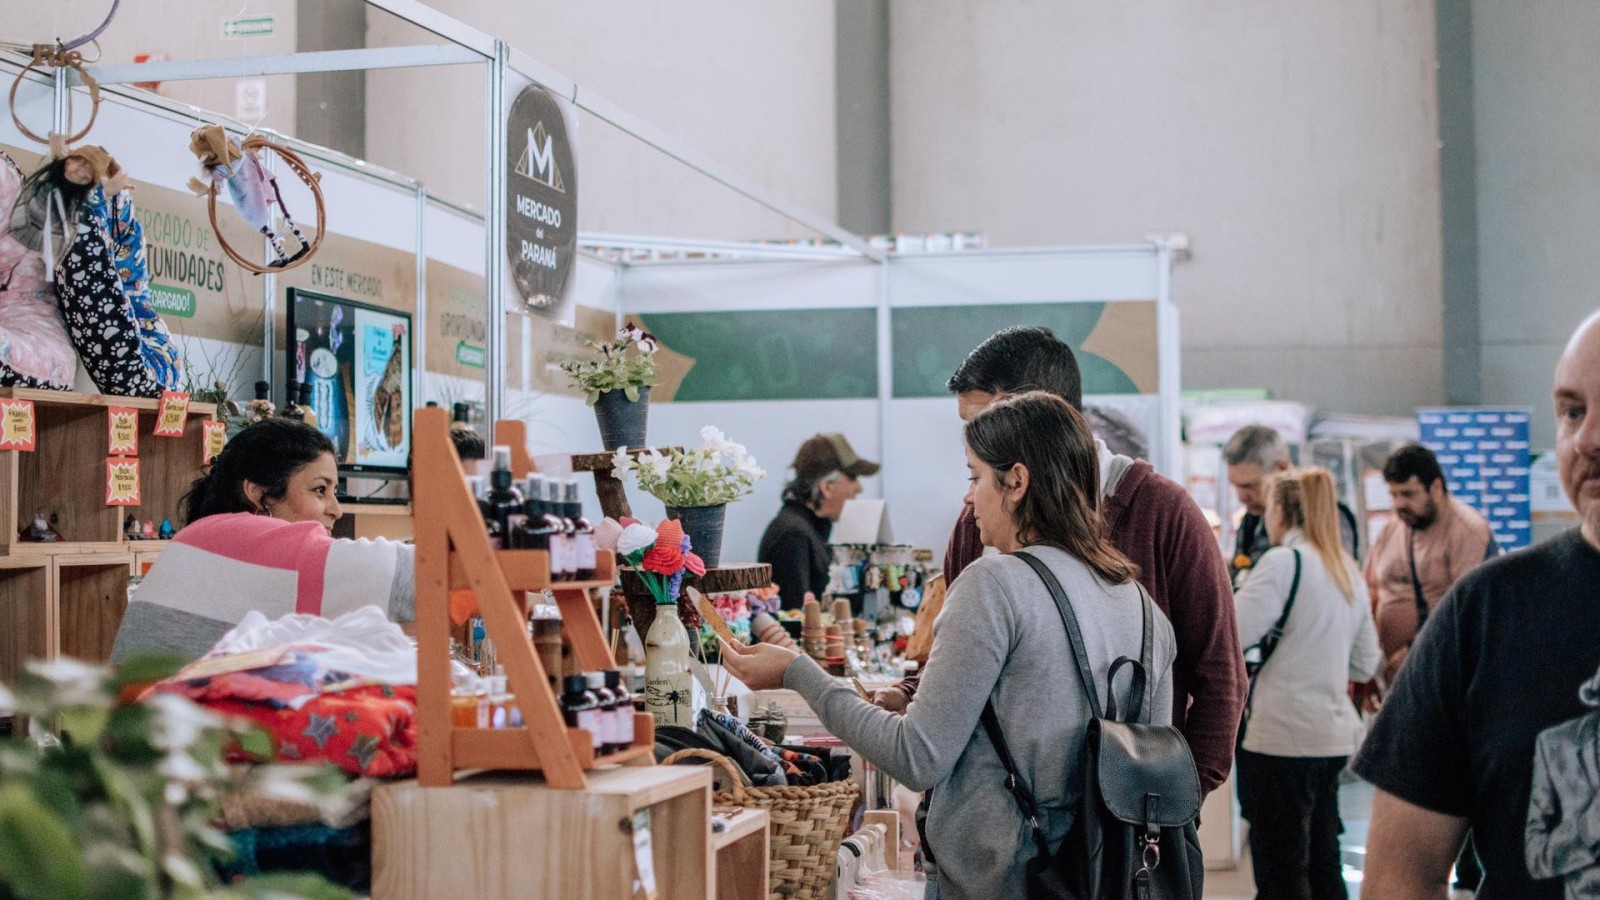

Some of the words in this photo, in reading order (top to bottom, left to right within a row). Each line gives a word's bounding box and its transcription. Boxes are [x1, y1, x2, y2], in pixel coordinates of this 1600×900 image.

[527, 127, 554, 187] M
[516, 194, 561, 229] MERCADO
[521, 239, 557, 269] PARANÁ
[325, 266, 344, 290] ESTE
